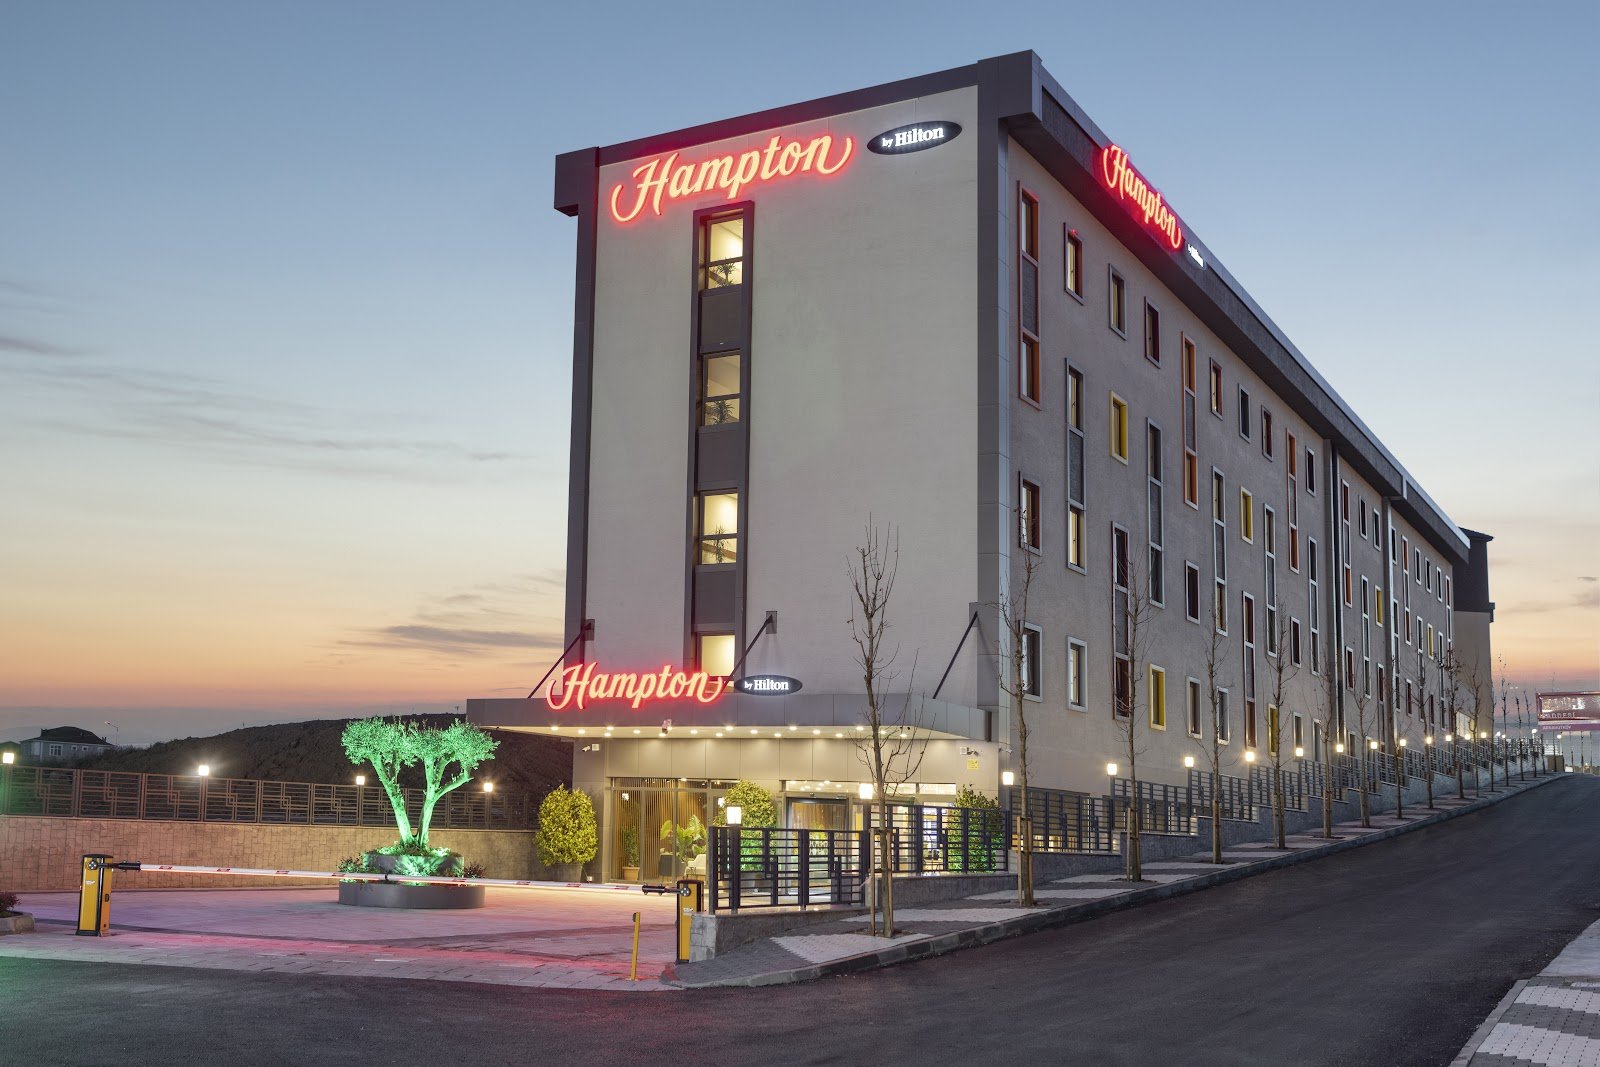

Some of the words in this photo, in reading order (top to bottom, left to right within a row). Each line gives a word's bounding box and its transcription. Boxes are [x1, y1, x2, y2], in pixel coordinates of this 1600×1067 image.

[882, 137, 894, 148] by
[895, 127, 944, 146] Hilton
[611, 135, 852, 222] Hampton
[1103, 145, 1182, 248] Hampton
[546, 661, 723, 710] Hampton
[744, 680, 753, 690] by
[754, 679, 789, 691] Hilton
